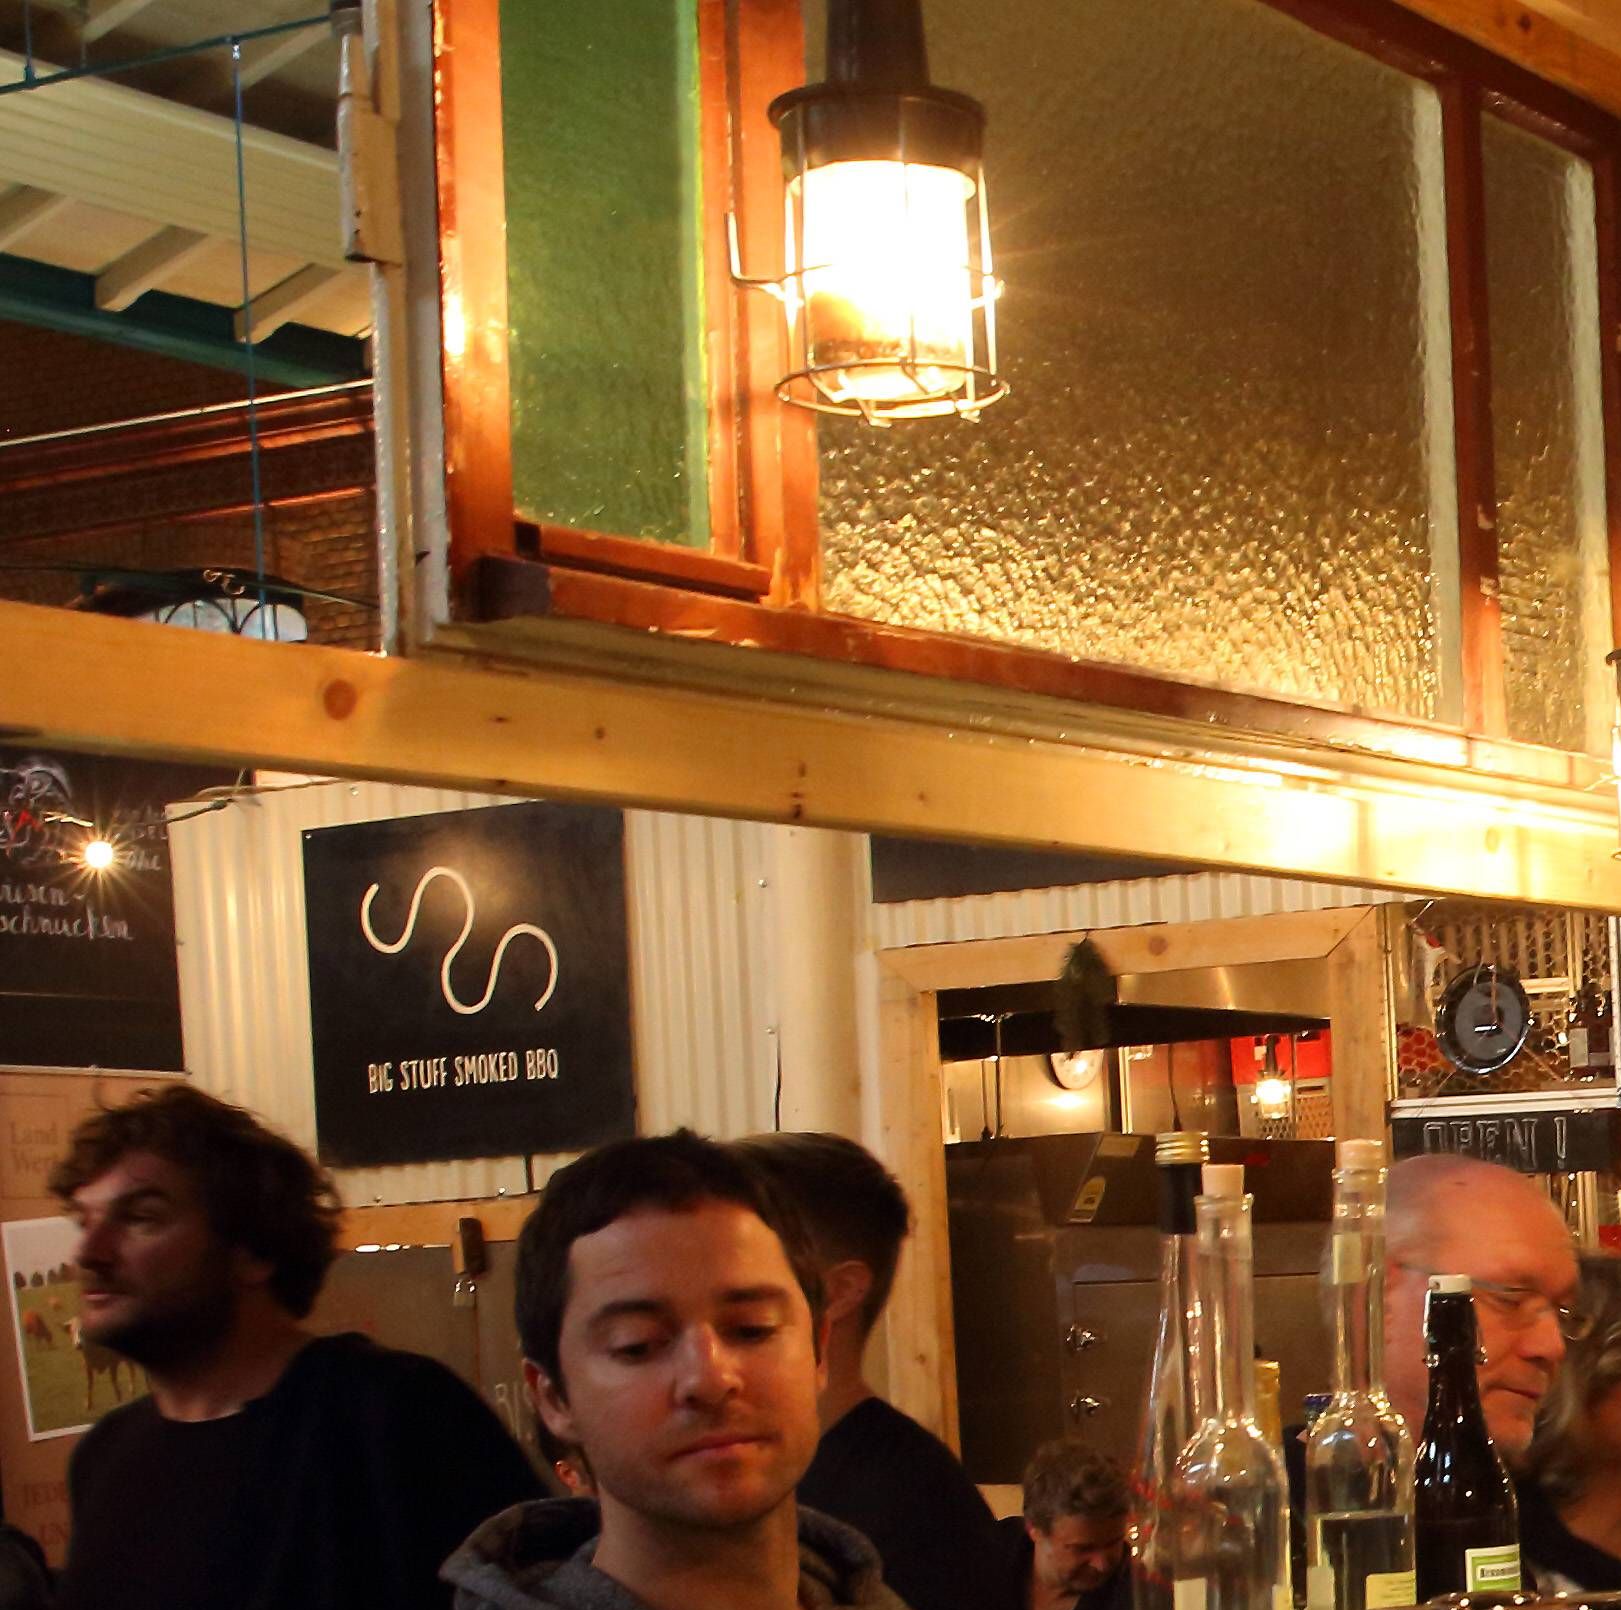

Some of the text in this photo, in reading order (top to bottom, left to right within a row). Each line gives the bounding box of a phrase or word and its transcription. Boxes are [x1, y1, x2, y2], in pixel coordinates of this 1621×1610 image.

[368, 1062, 394, 1094] BIG
[400, 1056, 448, 1091] STUFF
[454, 1051, 518, 1087] SMOKED
